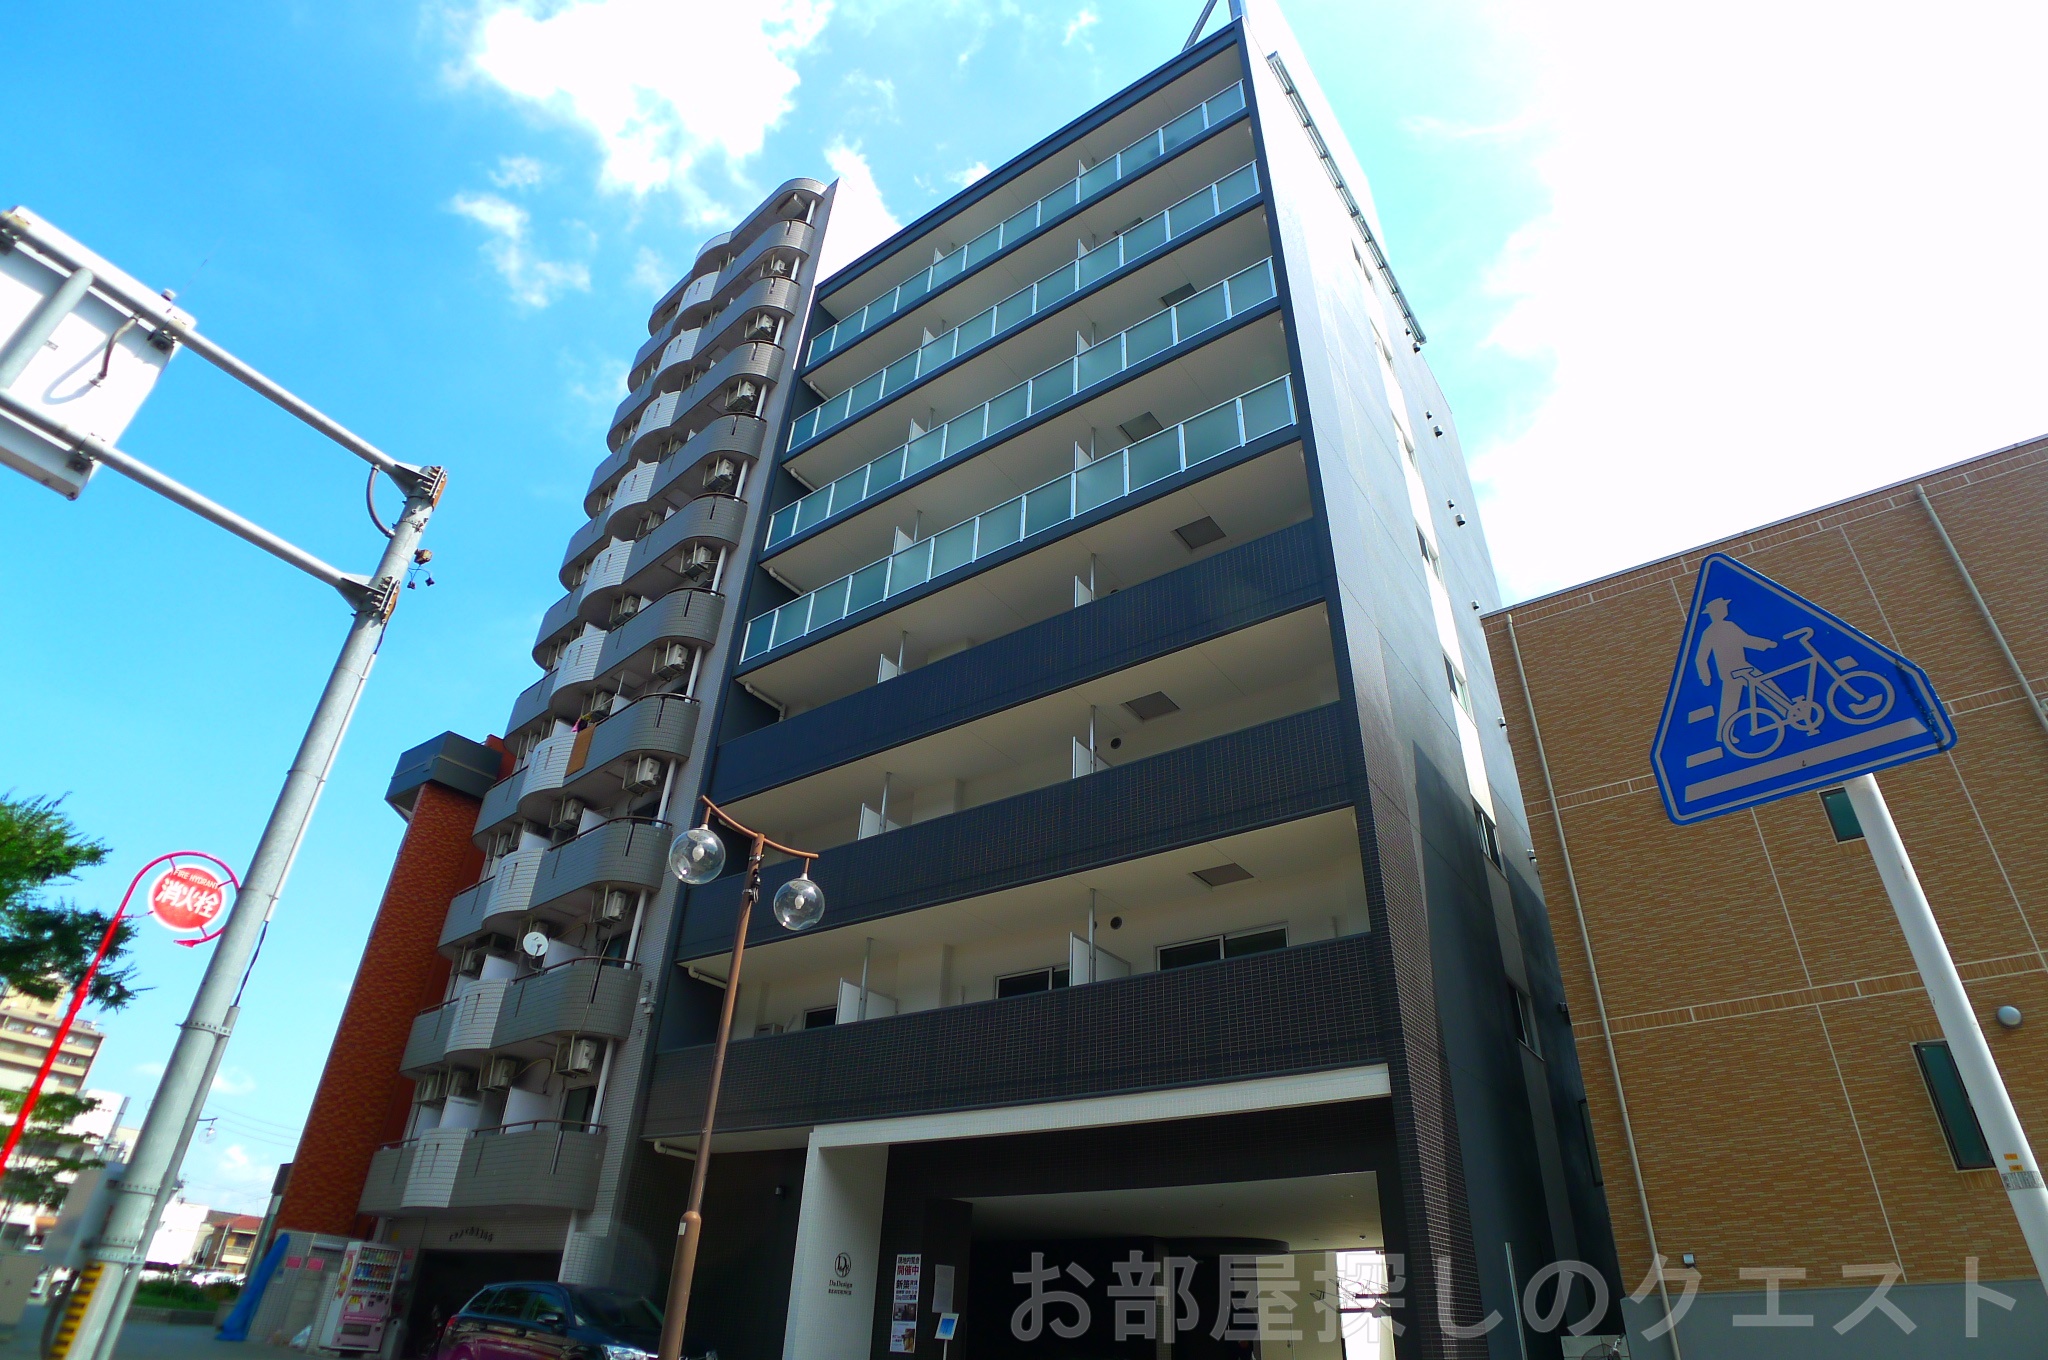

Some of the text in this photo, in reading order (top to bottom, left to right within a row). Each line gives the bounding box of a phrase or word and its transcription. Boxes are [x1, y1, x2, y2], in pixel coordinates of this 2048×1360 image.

[173, 869, 220, 890] FIRE HYDRANT
[155, 878, 219, 918] 消火栓
